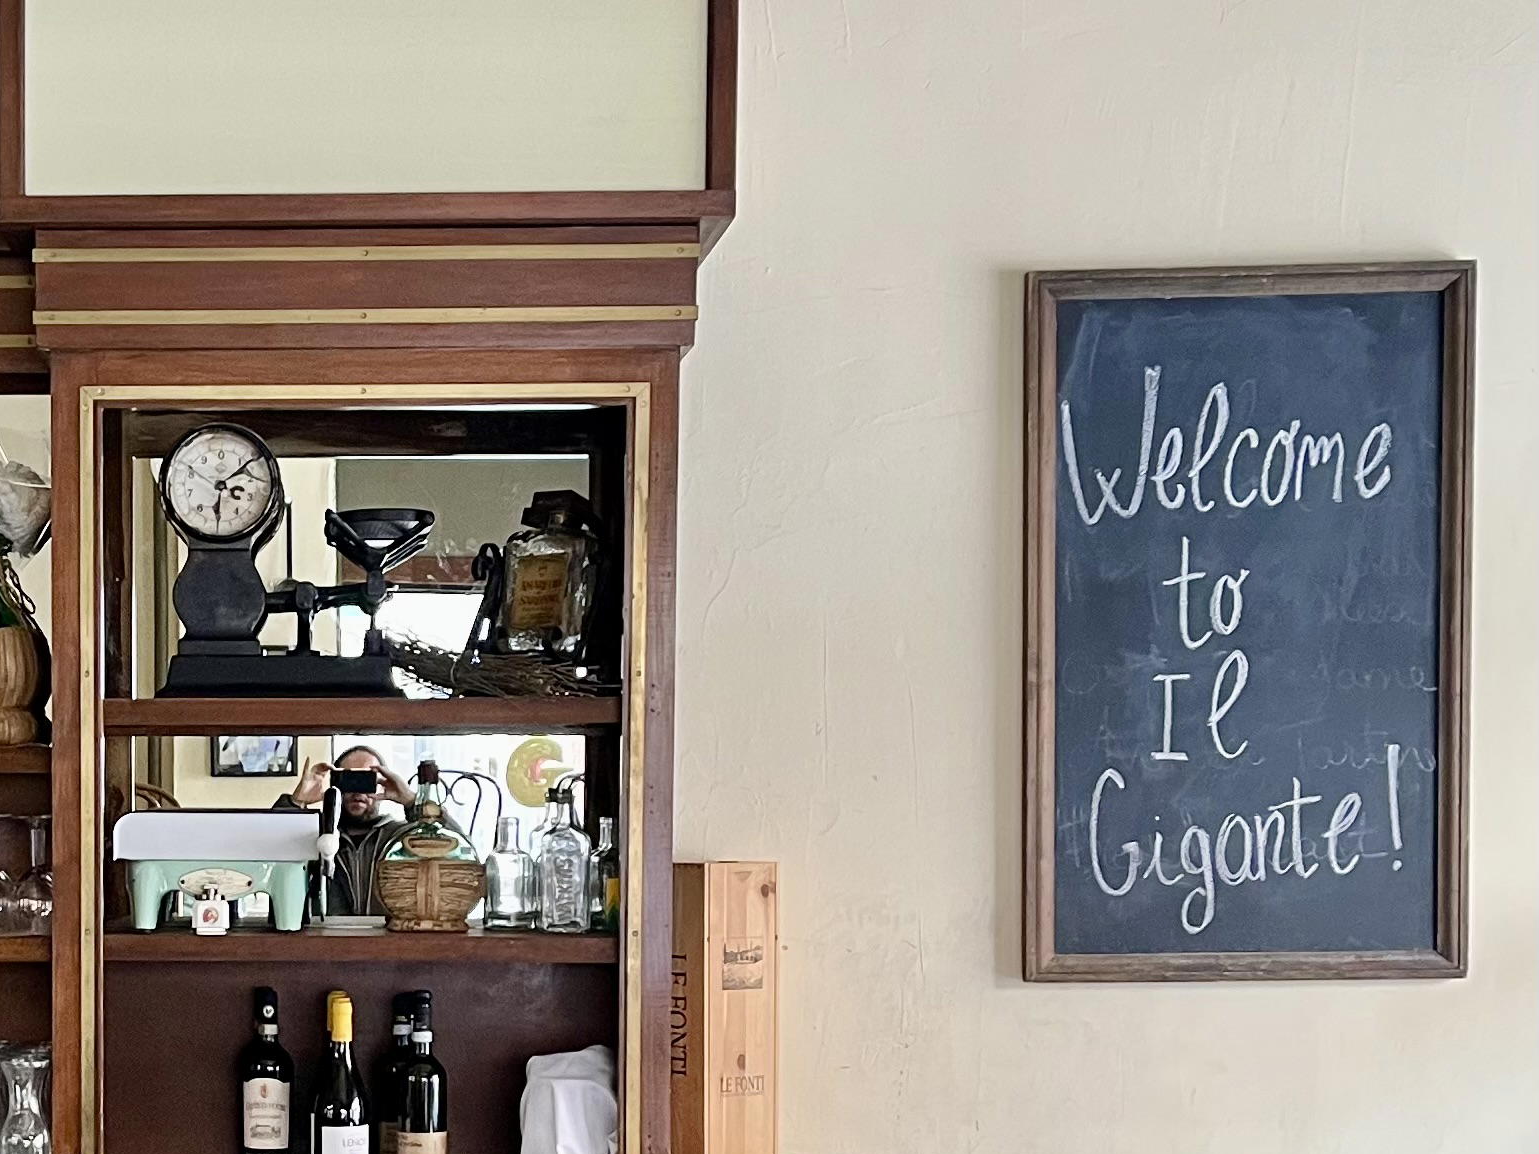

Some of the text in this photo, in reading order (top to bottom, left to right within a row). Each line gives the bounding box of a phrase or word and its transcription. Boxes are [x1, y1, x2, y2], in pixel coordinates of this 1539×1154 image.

[1062, 366, 1393, 526] Welcome
[1163, 536, 1251, 652] to
[1151, 650, 1250, 762] Il
[1090, 743, 1404, 935] Gigante!
